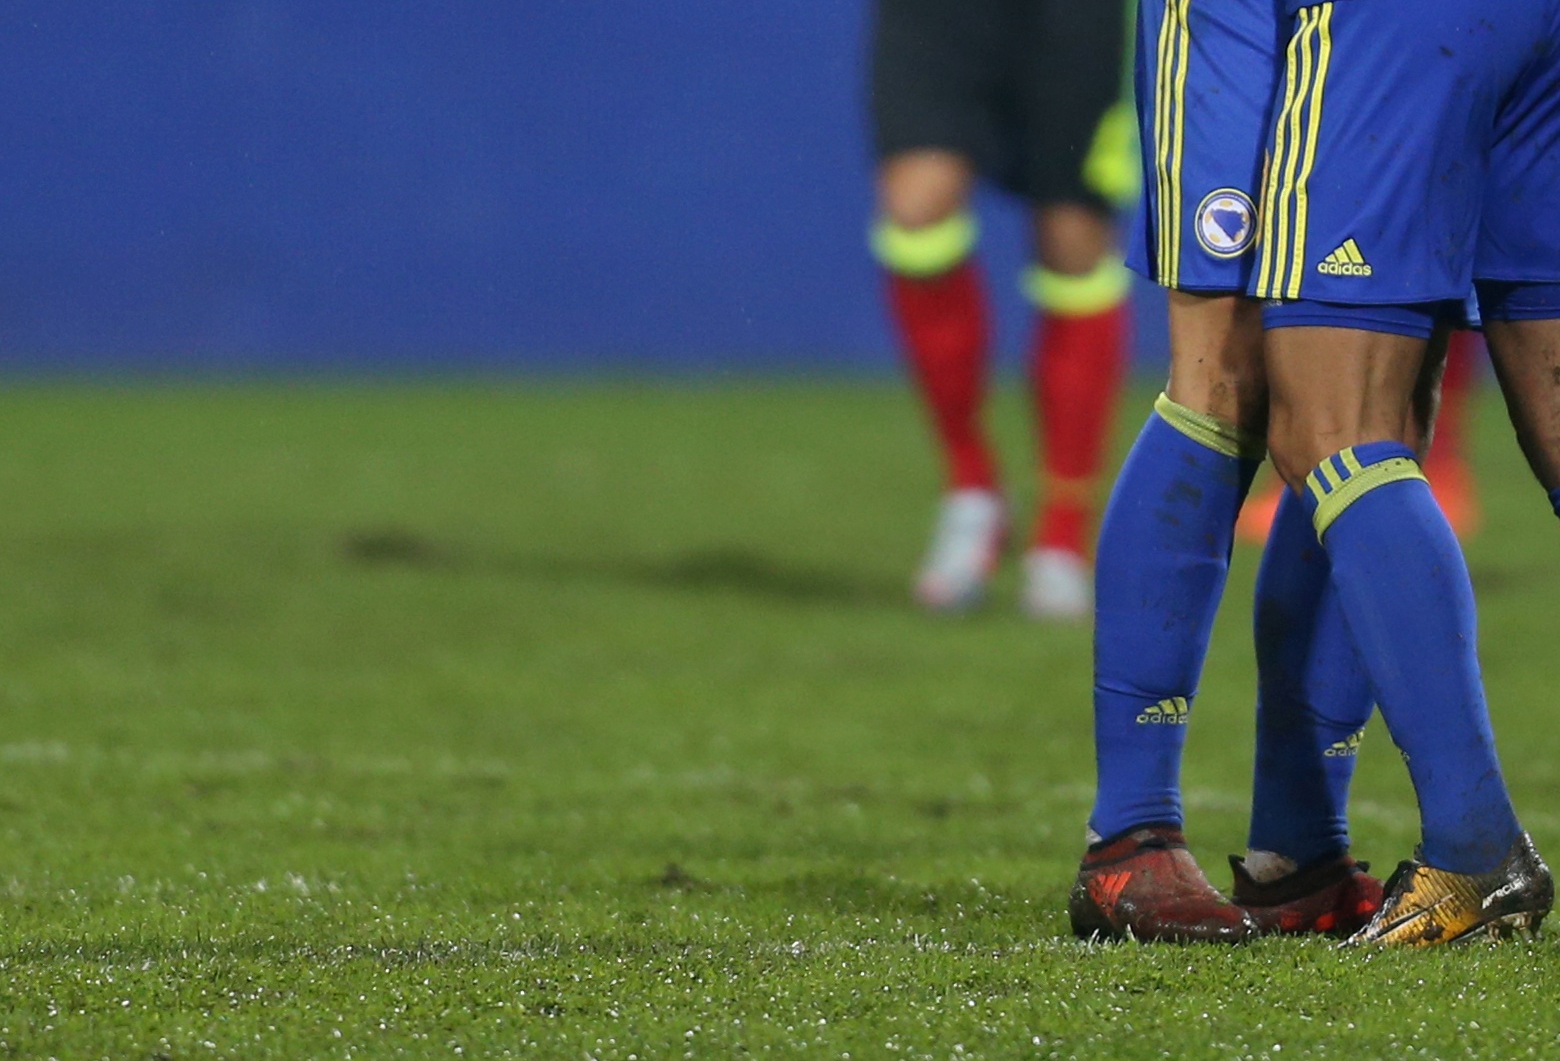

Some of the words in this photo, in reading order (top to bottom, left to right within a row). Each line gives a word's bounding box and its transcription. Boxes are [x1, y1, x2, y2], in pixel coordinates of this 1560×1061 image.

[1317, 261, 1372, 276] adidas
[1136, 712, 1188, 724] adida
[1324, 746, 1358, 757] adid
